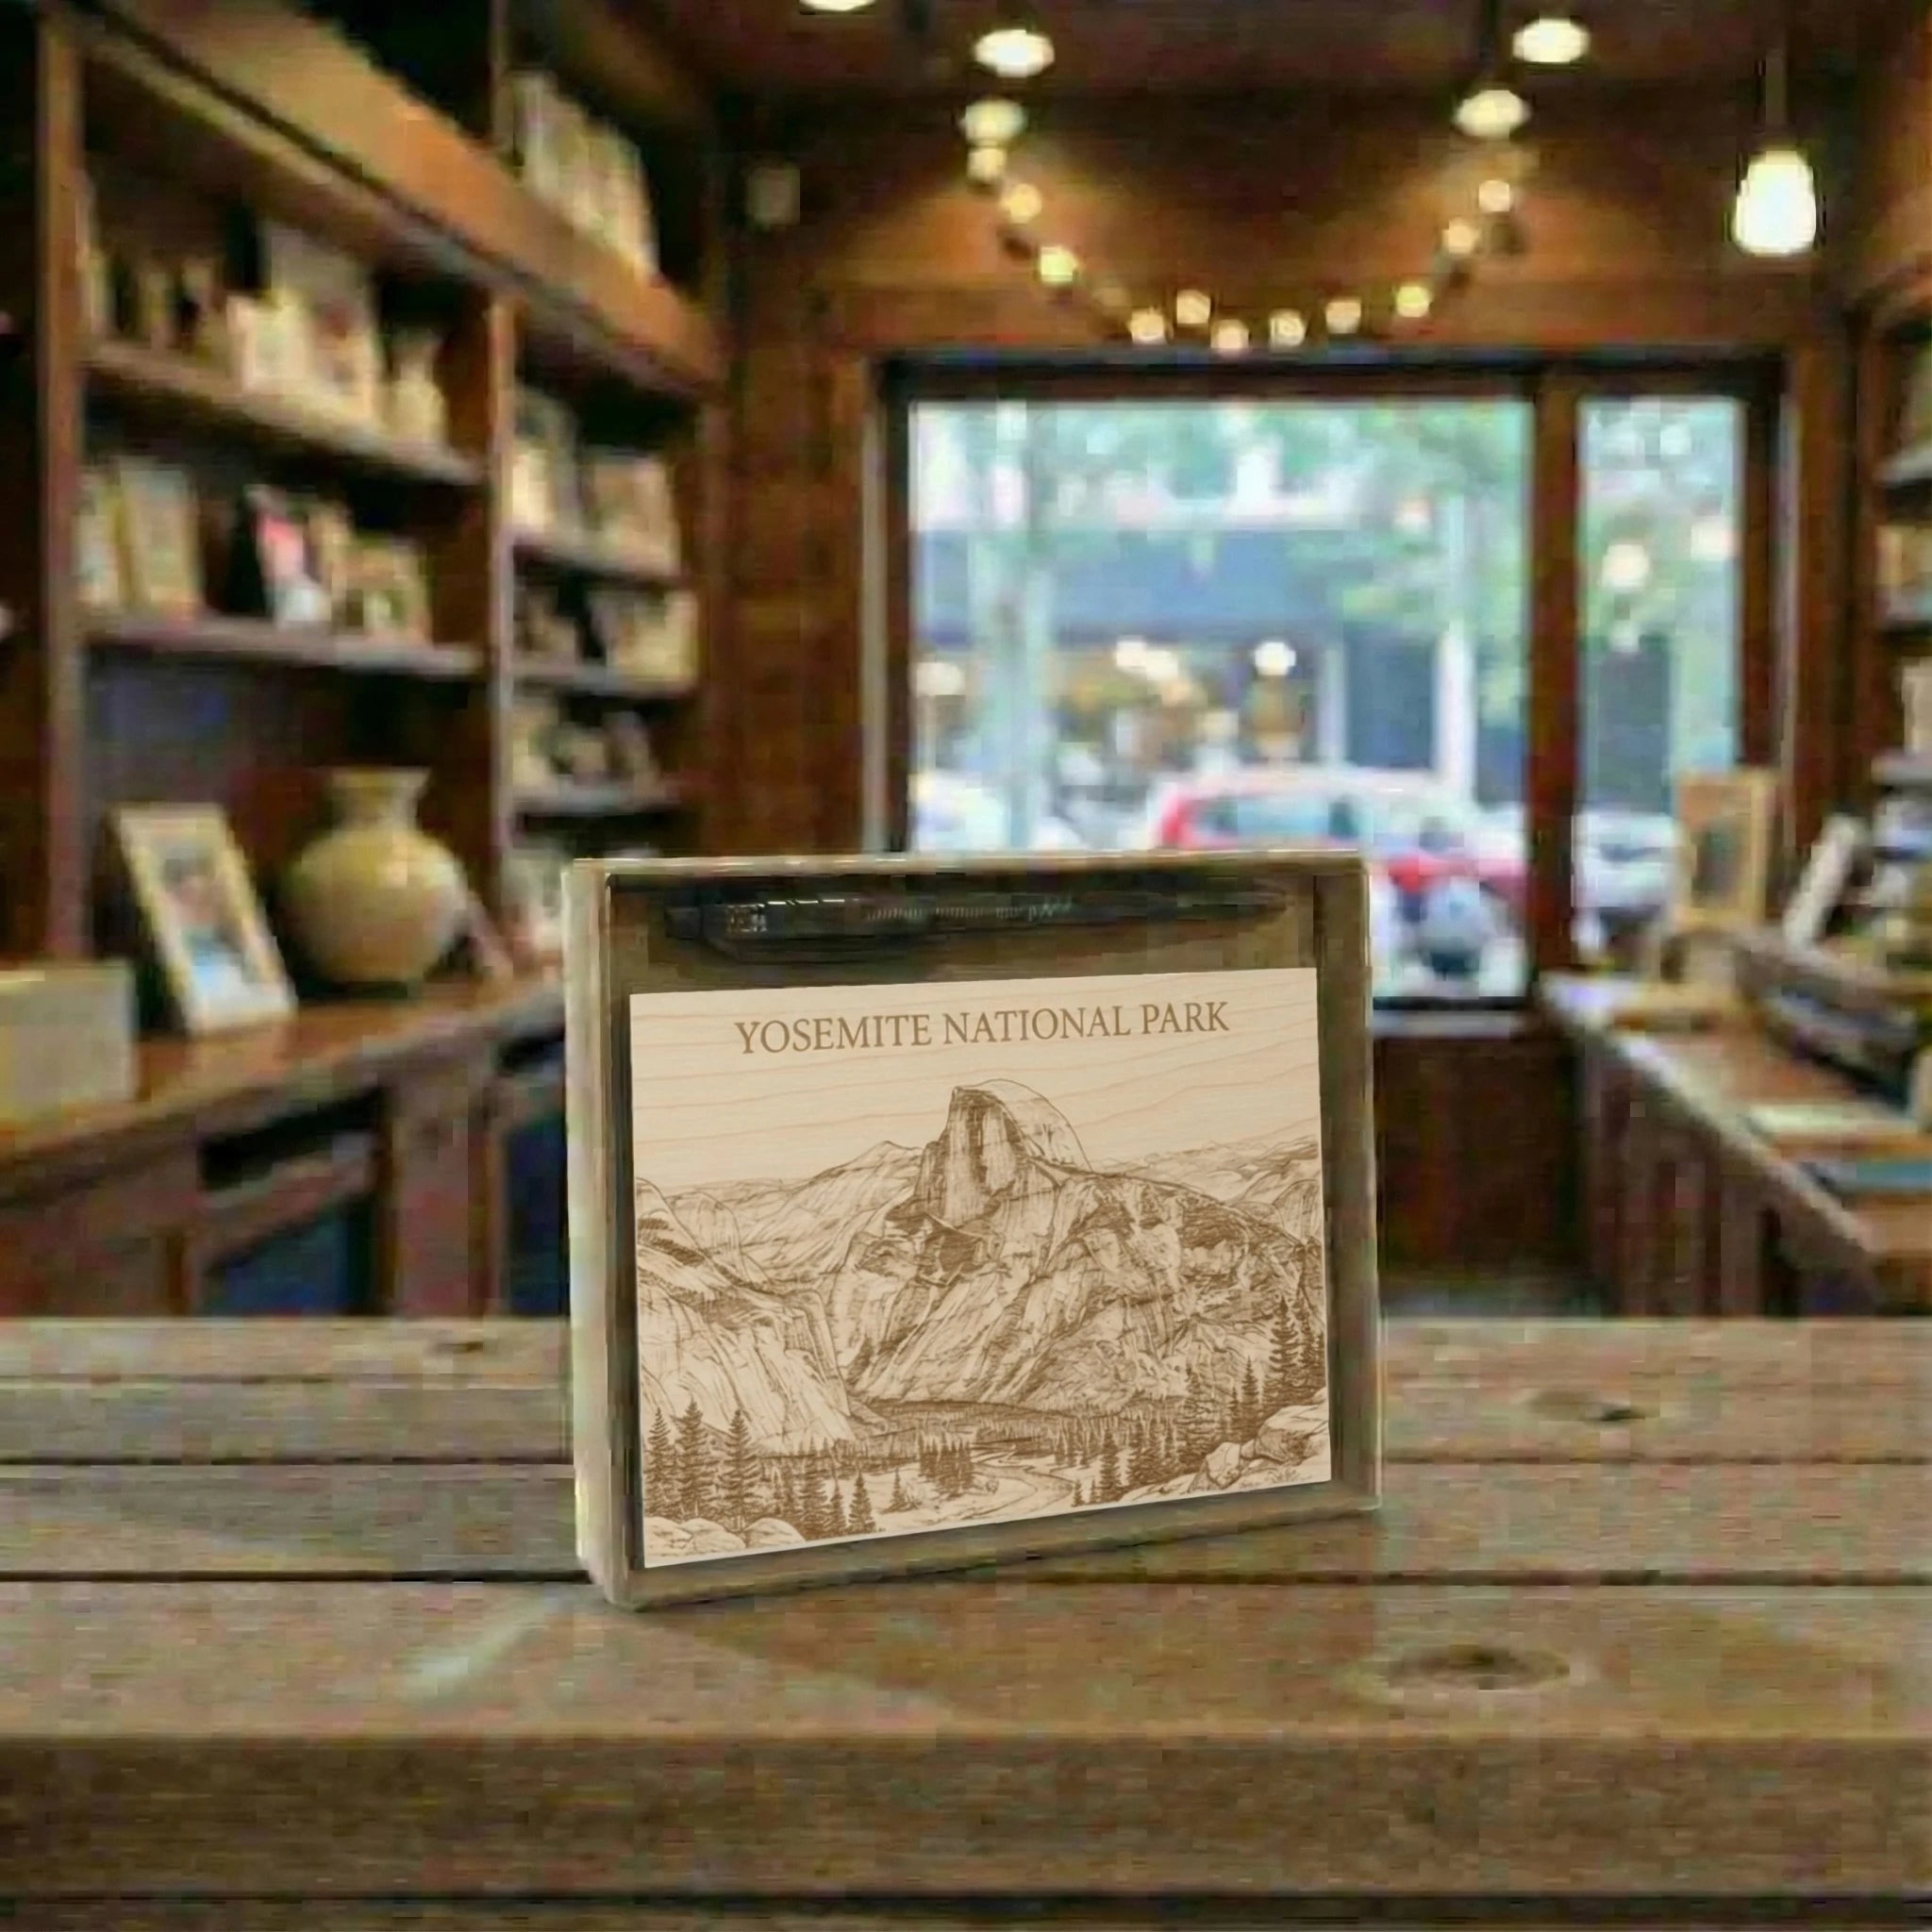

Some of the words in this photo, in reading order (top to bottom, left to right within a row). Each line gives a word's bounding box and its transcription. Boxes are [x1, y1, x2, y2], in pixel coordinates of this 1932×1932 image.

[734, 1014, 932, 1055] YOSEMITE
[942, 1005, 1131, 1045] NATIONAL
[1141, 1001, 1230, 1035] PARK
